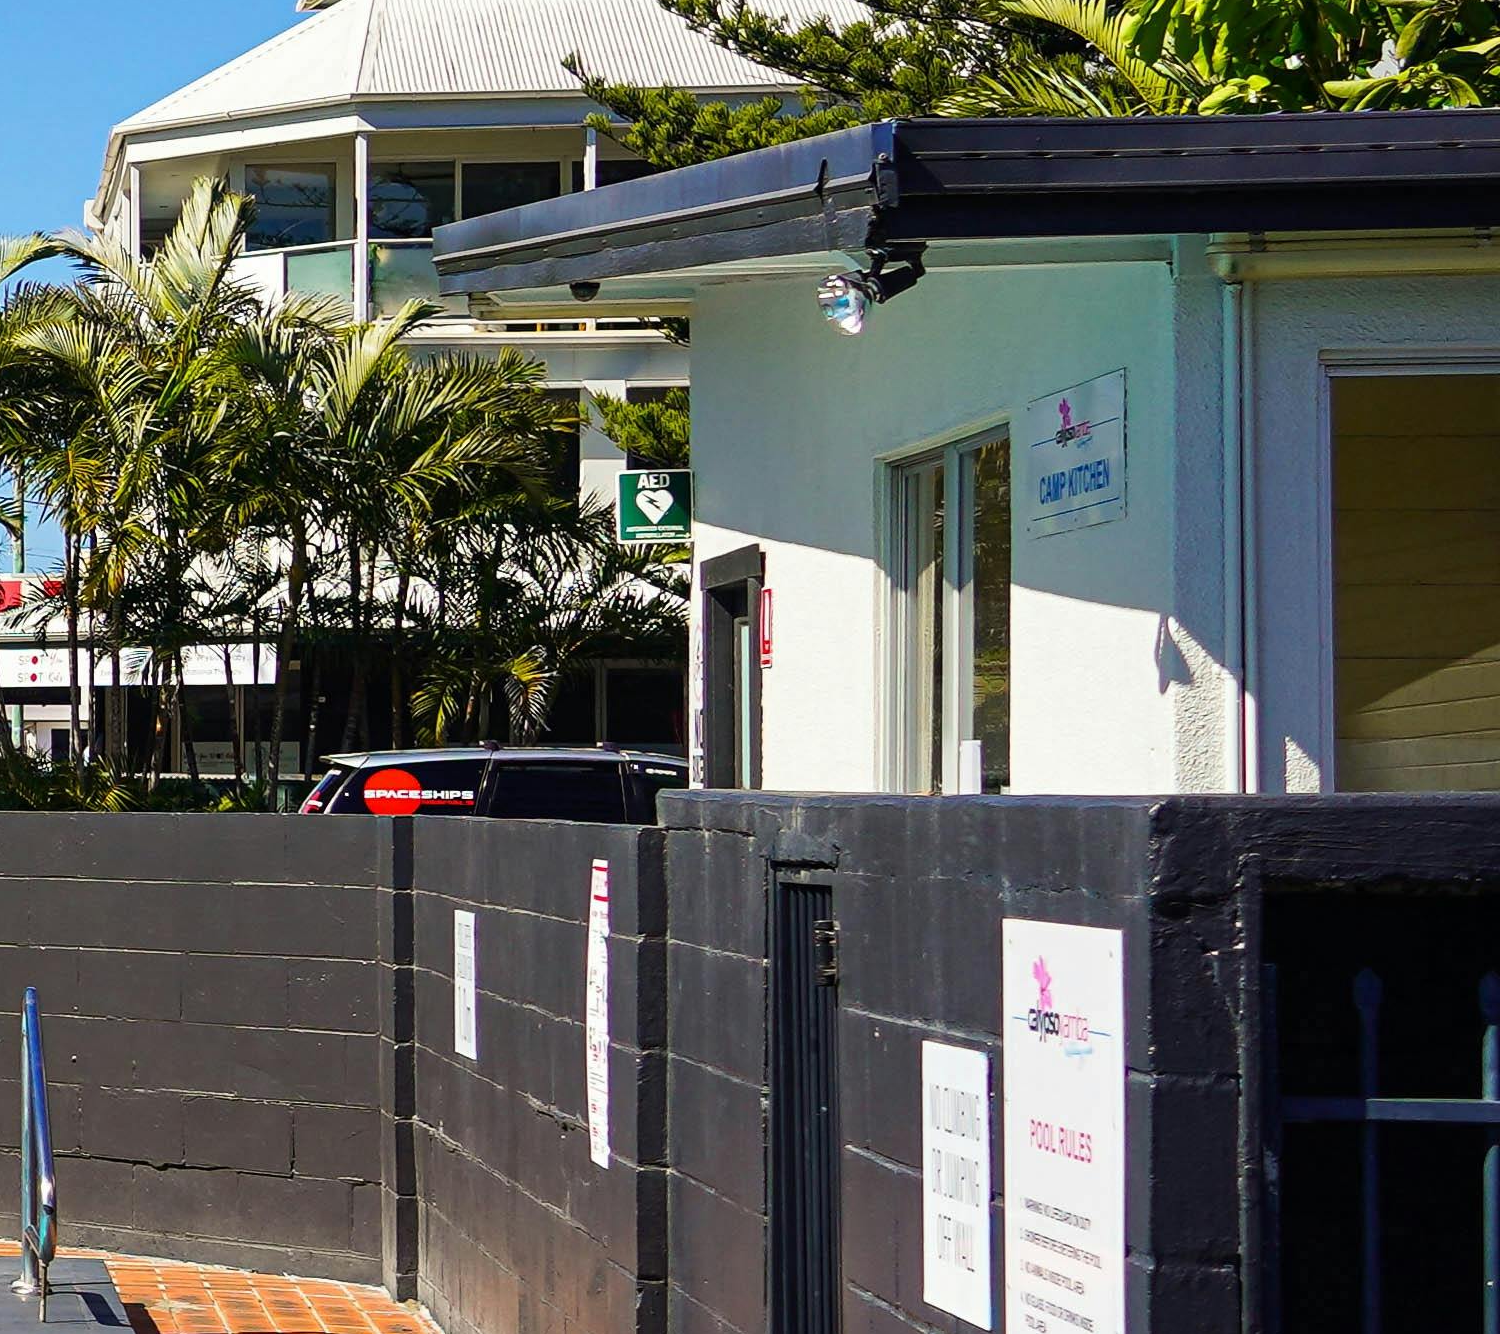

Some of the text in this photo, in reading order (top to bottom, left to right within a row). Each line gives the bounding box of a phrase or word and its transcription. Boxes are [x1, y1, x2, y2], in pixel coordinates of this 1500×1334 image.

[637, 473, 670, 489] AED
[1040, 458, 1110, 505] CAMP KITCHEN
[17, 672, 44, 683] SPOT
[364, 789, 474, 800] SPACESHIPS
[1030, 1119, 1093, 1164] POOL RULES
